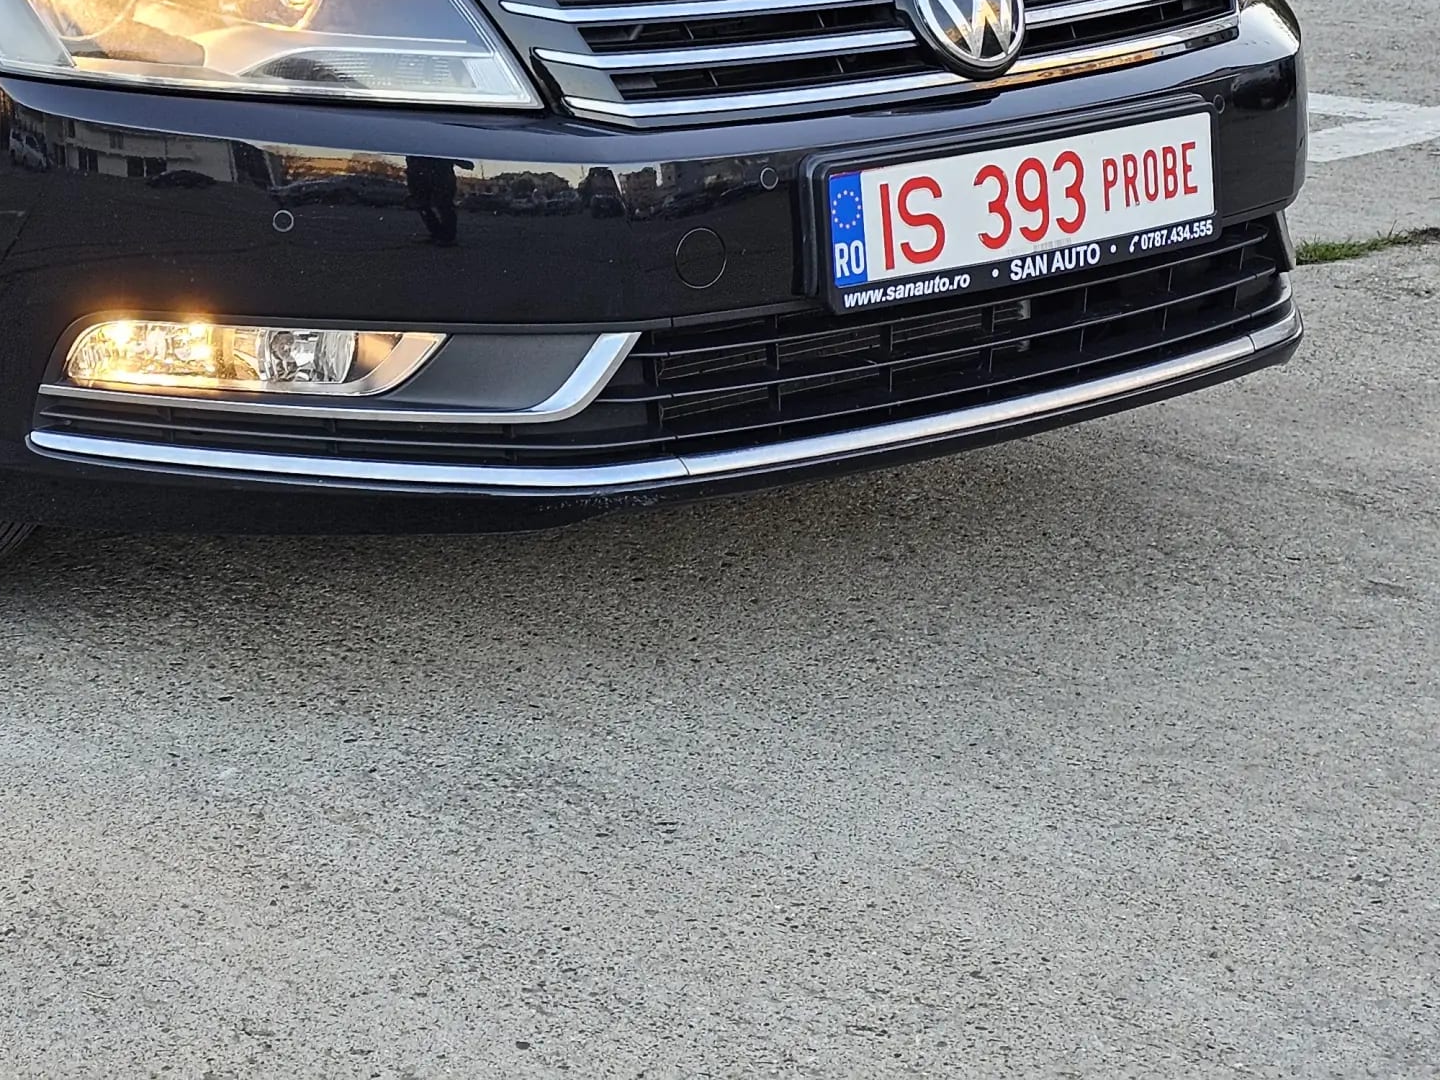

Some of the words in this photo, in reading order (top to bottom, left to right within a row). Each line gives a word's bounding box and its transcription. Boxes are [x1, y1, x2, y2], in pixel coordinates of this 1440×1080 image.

[879, 176, 946, 270] IS
[973, 150, 1086, 250] 393
[1102, 141, 1198, 212] PROBE
[1140, 219, 1214, 251] 0787.434.555
[834, 239, 864, 279] RO
[1009, 253, 1048, 281] SAN
[1051, 242, 1101, 273] AUTO
[844, 273, 971, 308] www.sanauto.ro
